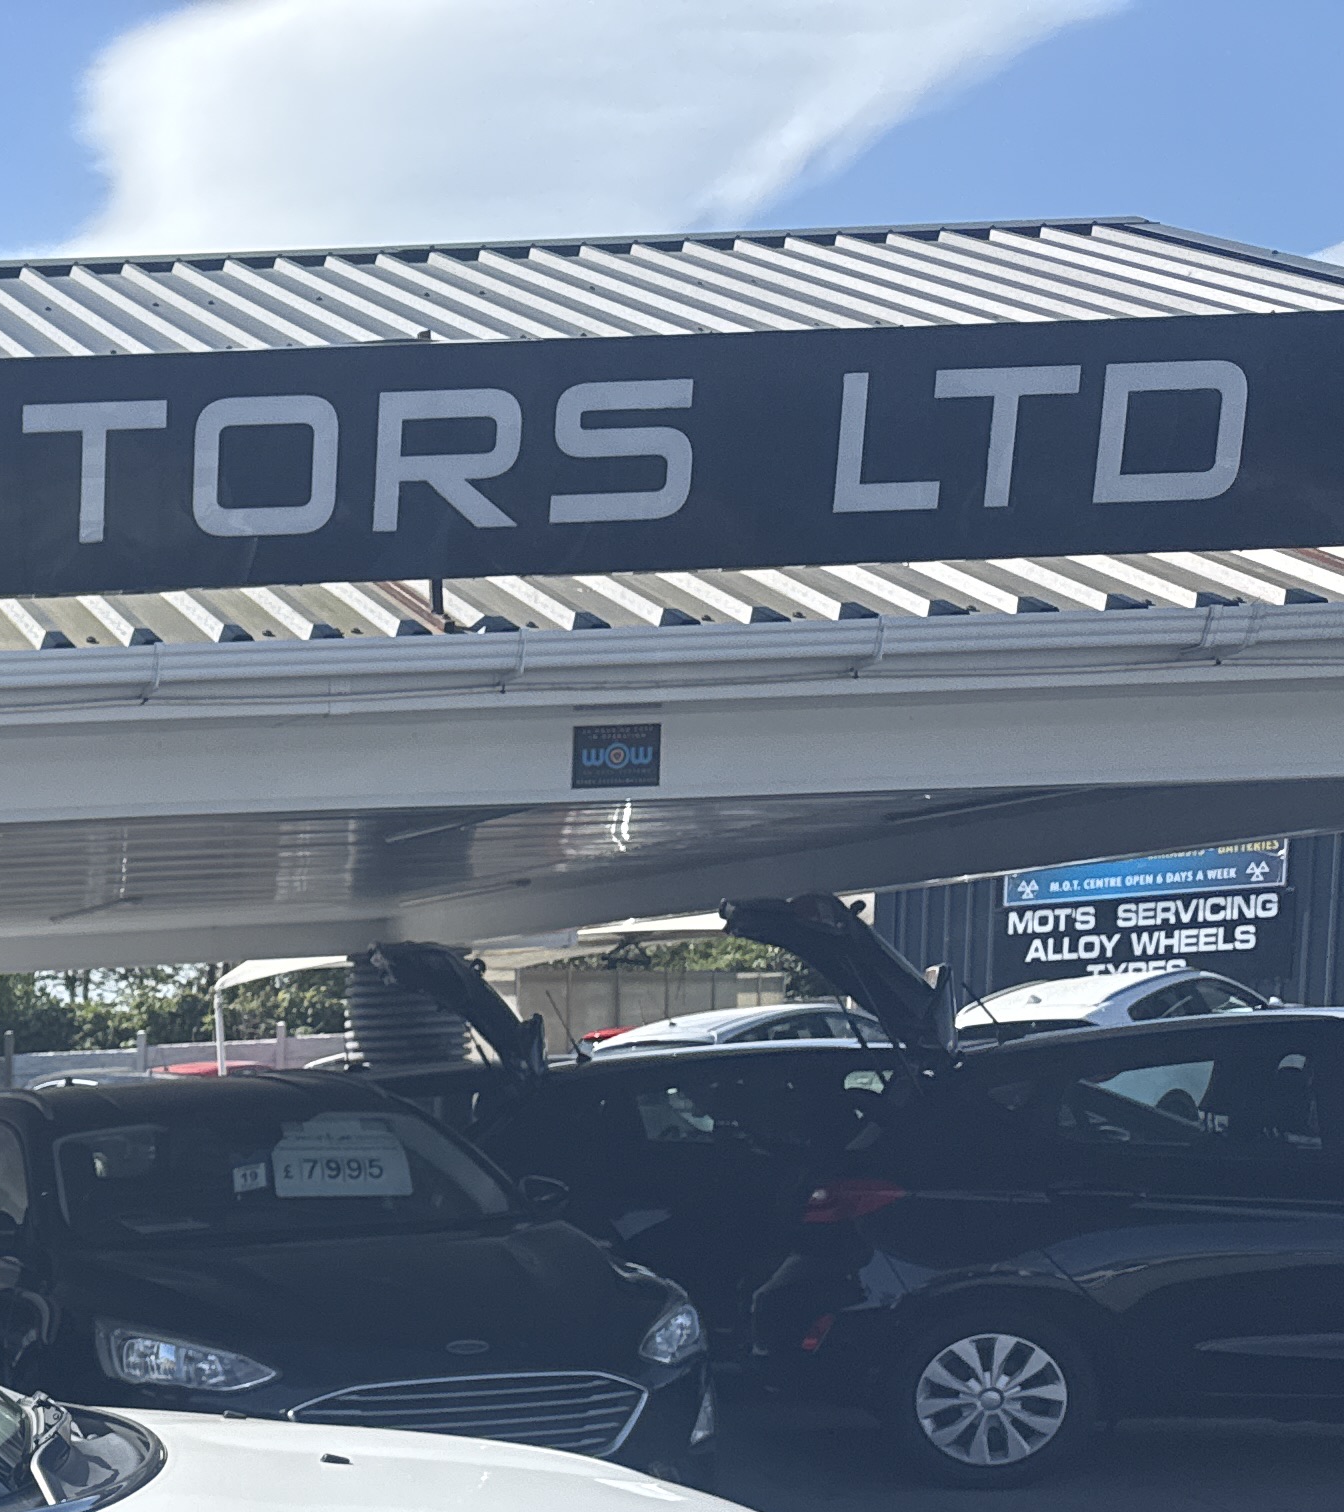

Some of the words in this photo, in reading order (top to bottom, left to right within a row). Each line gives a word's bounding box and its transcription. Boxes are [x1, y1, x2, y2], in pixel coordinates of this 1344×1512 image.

[833, 361, 1248, 512] LTD
[1083, 875, 1123, 890] CENTRE
[1125, 873, 1154, 887] OPEN
[1156, 874, 1164, 884] 6
[1166, 870, 1193, 883] DAYS
[1196, 870, 1204, 881] A
[1206, 867, 1237, 880] WEEK
[1007, 905, 1096, 935] MOT'S
[1116, 893, 1279, 928] SERVICING
[1024, 933, 1122, 963] ALLOY
[1130, 924, 1257, 956] WHEELS
